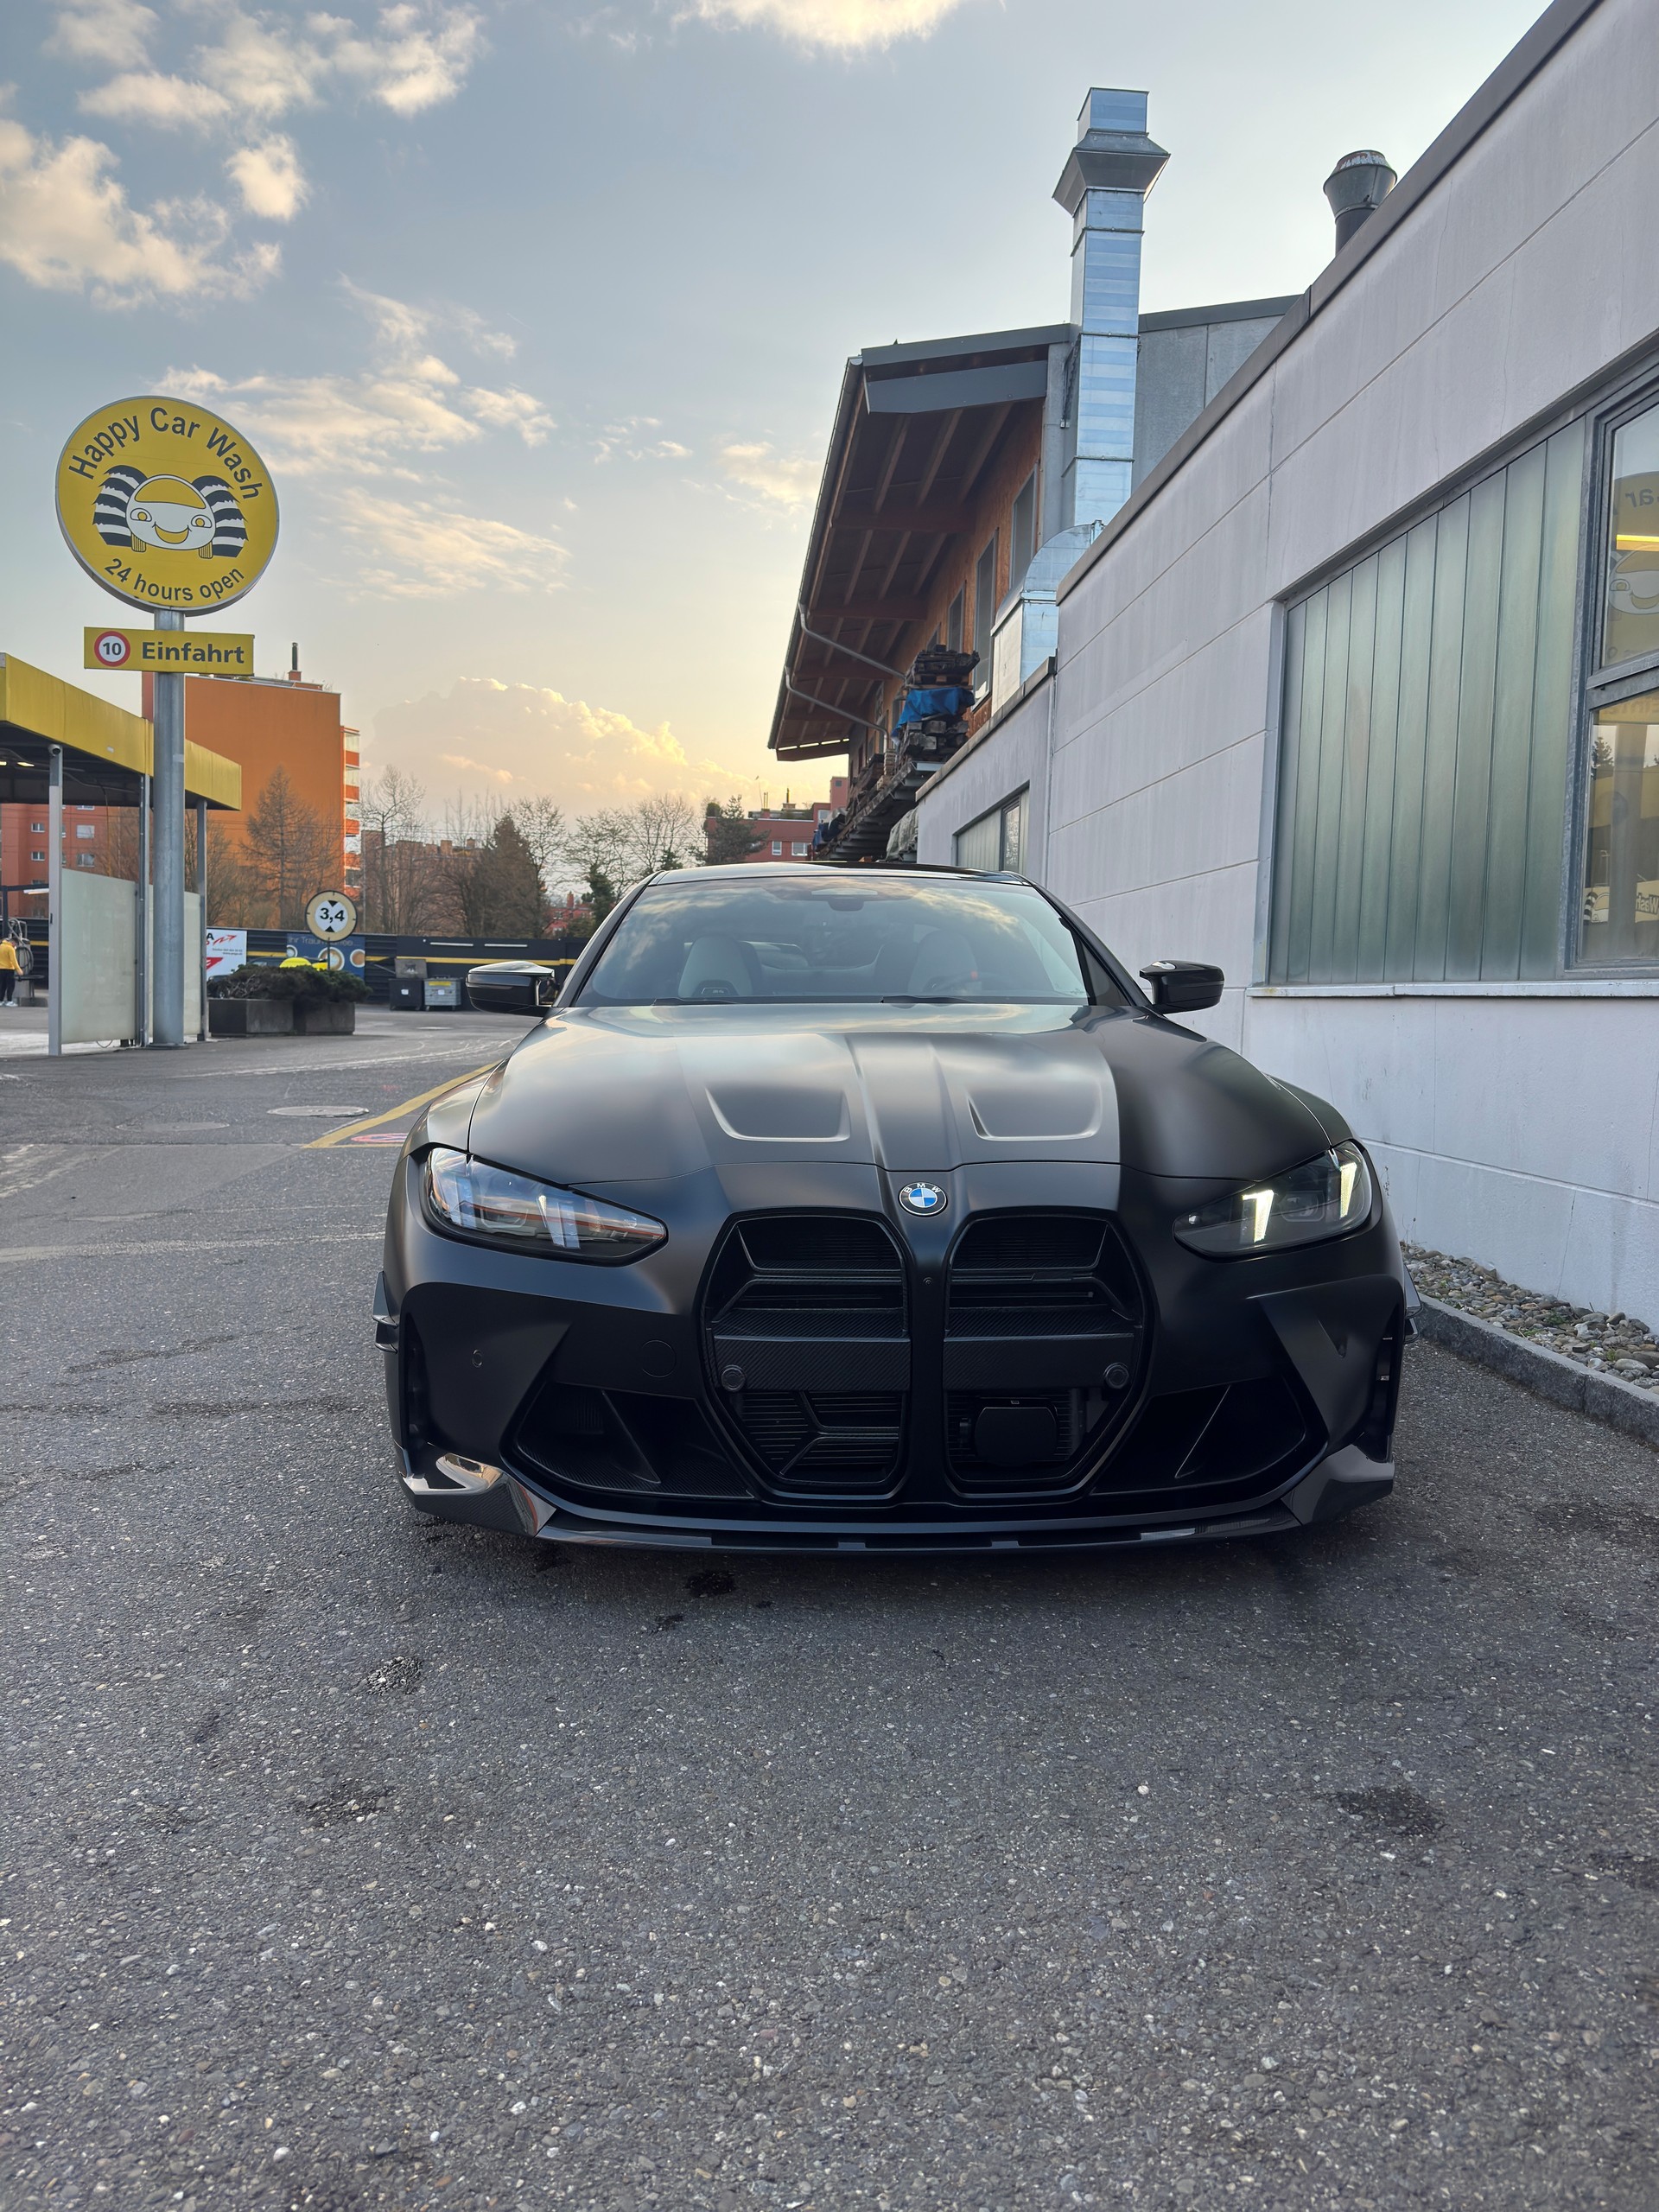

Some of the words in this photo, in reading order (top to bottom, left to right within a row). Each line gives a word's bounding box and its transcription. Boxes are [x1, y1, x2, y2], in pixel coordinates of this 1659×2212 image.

[68, 415, 140, 480] Happy
[150, 407, 200, 438] Car
[206, 427, 263, 499] Wash
[105, 557, 132, 583] 24
[133, 573, 194, 601] hours
[200, 567, 245, 600] open
[102, 642, 122, 656] 10
[142, 641, 245, 664] Einfahrt
[320, 907, 345, 923] 3,4
[903, 1183, 941, 1193] BMW
